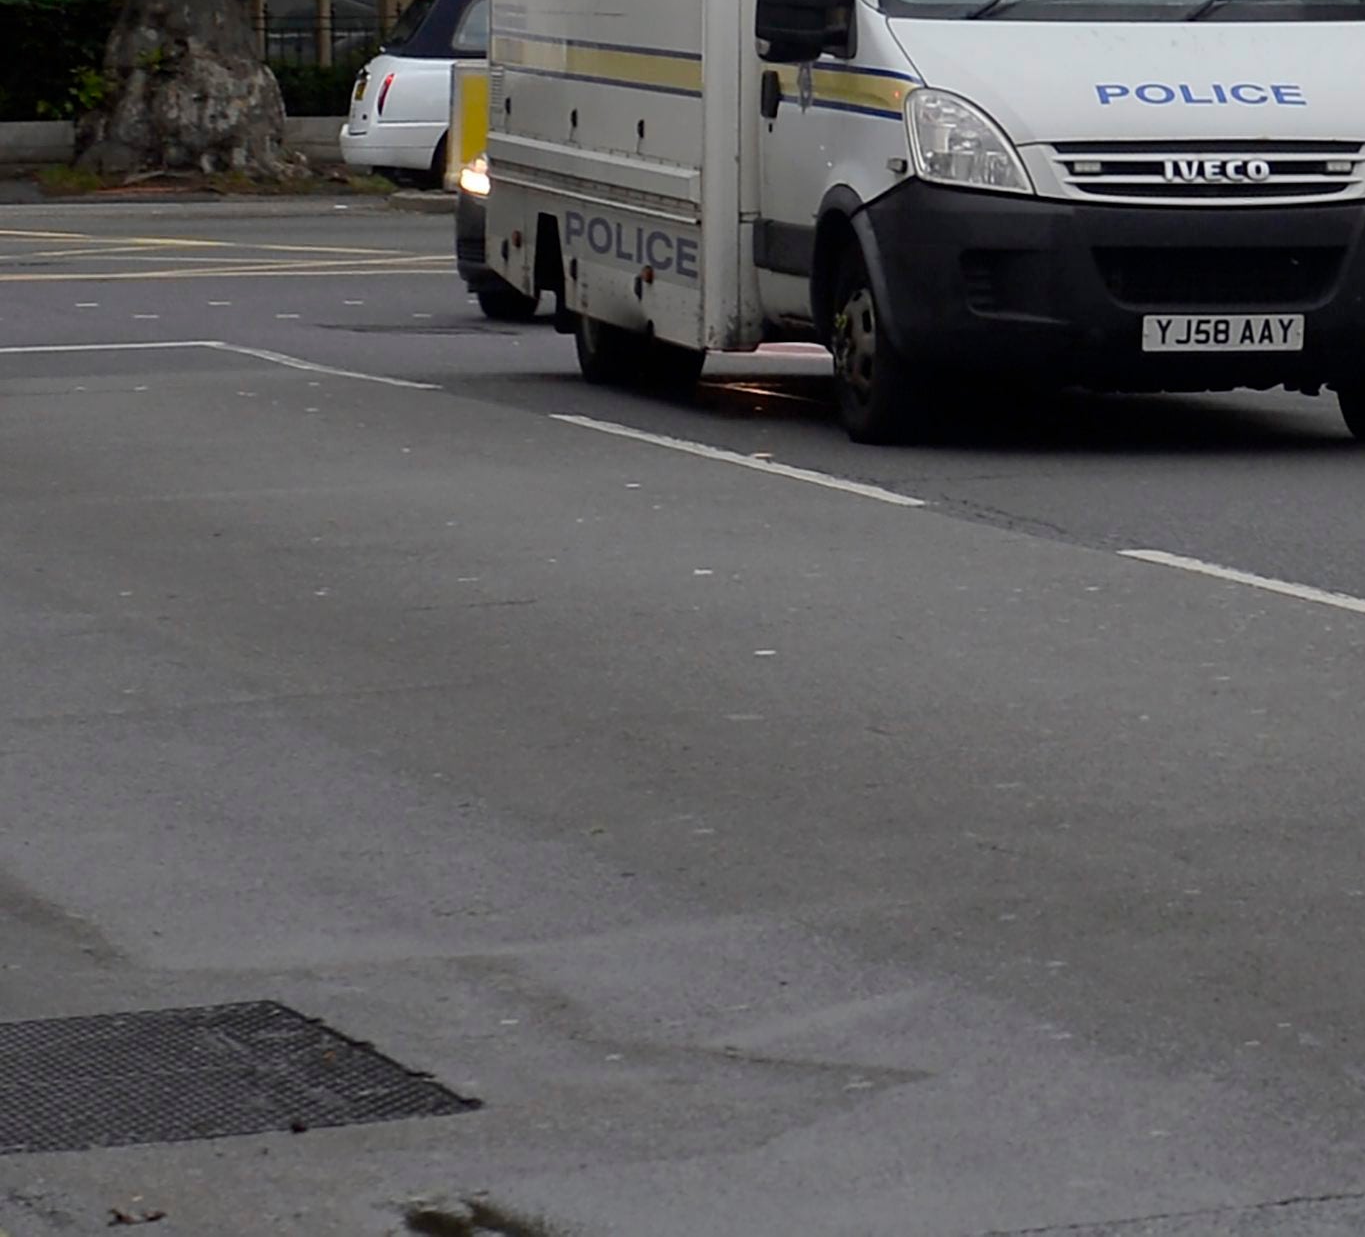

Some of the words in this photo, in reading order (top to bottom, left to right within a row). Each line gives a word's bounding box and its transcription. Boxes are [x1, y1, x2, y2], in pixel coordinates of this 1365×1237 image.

[1096, 84, 1307, 105] POLICE
[1164, 160, 1270, 183] IVECO
[565, 210, 699, 279] POLICE
[1156, 319, 1230, 345] YJ58
[1240, 319, 1294, 344] AAY
